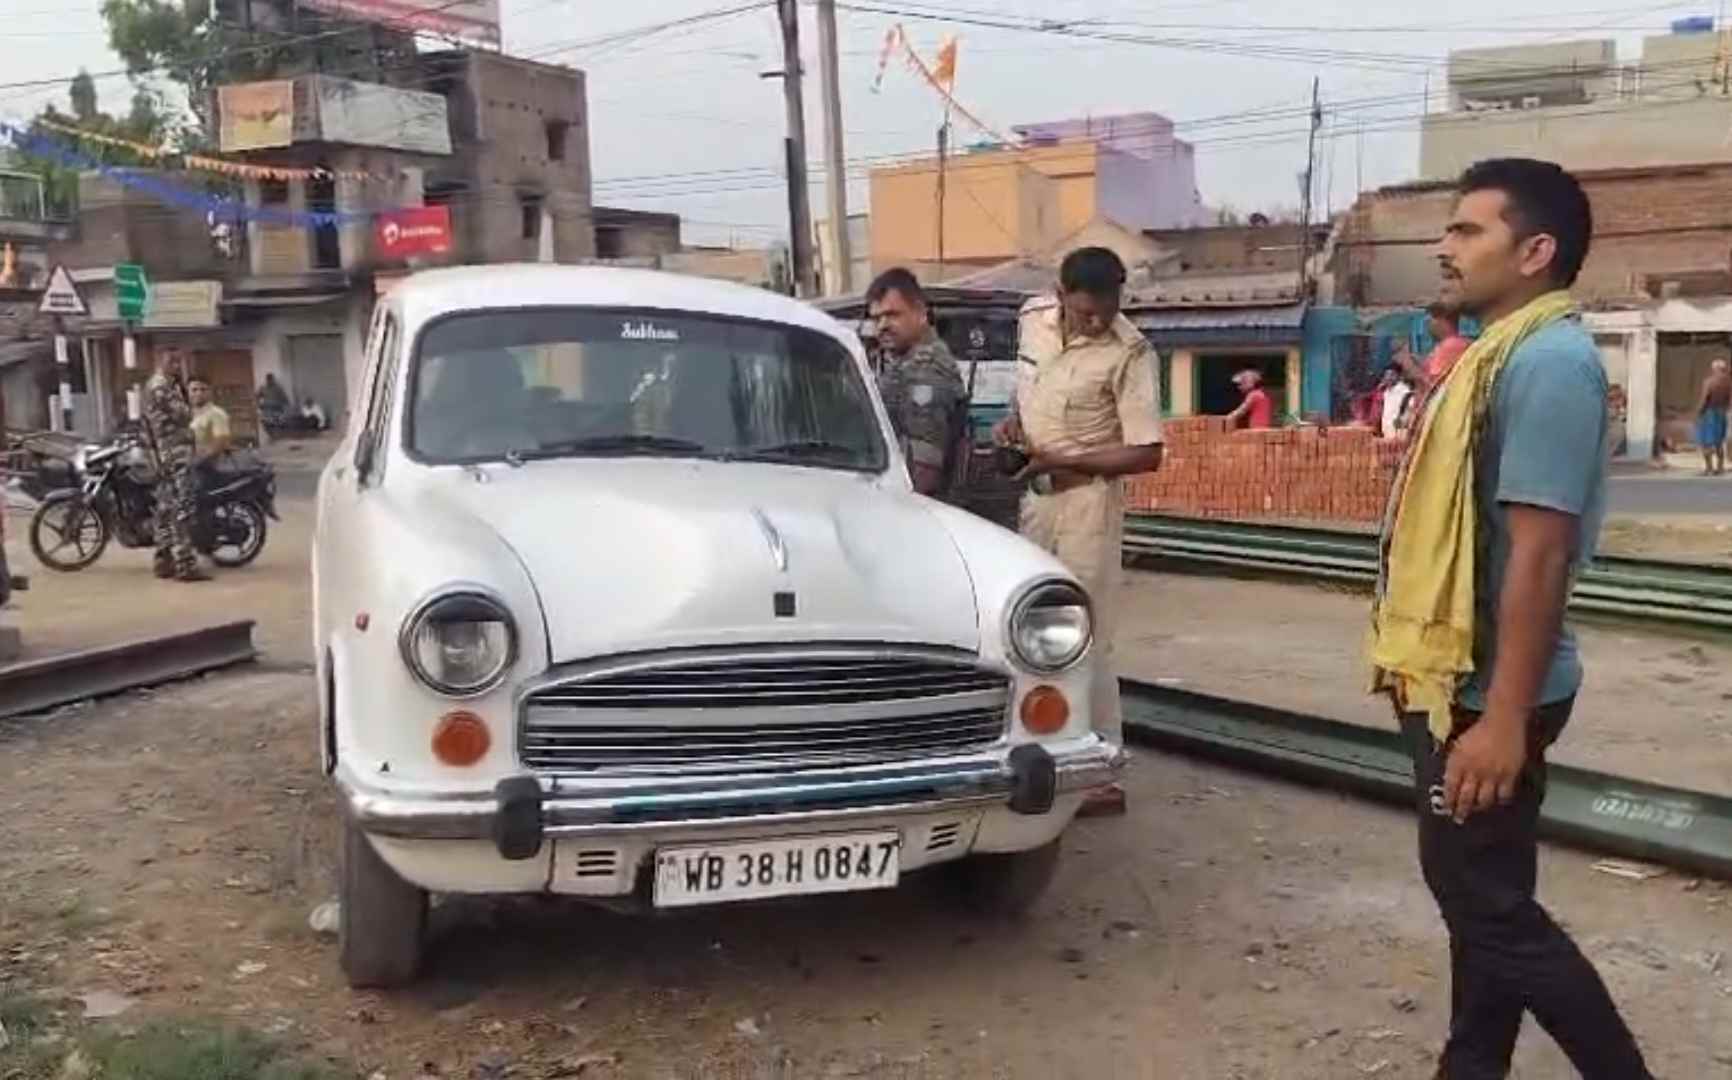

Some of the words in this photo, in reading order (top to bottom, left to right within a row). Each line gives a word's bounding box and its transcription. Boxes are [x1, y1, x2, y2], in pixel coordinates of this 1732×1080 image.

[686, 856, 724, 892] WB
[737, 853, 774, 886] 38
[786, 850, 803, 883] H
[815, 842, 898, 880] 0847
